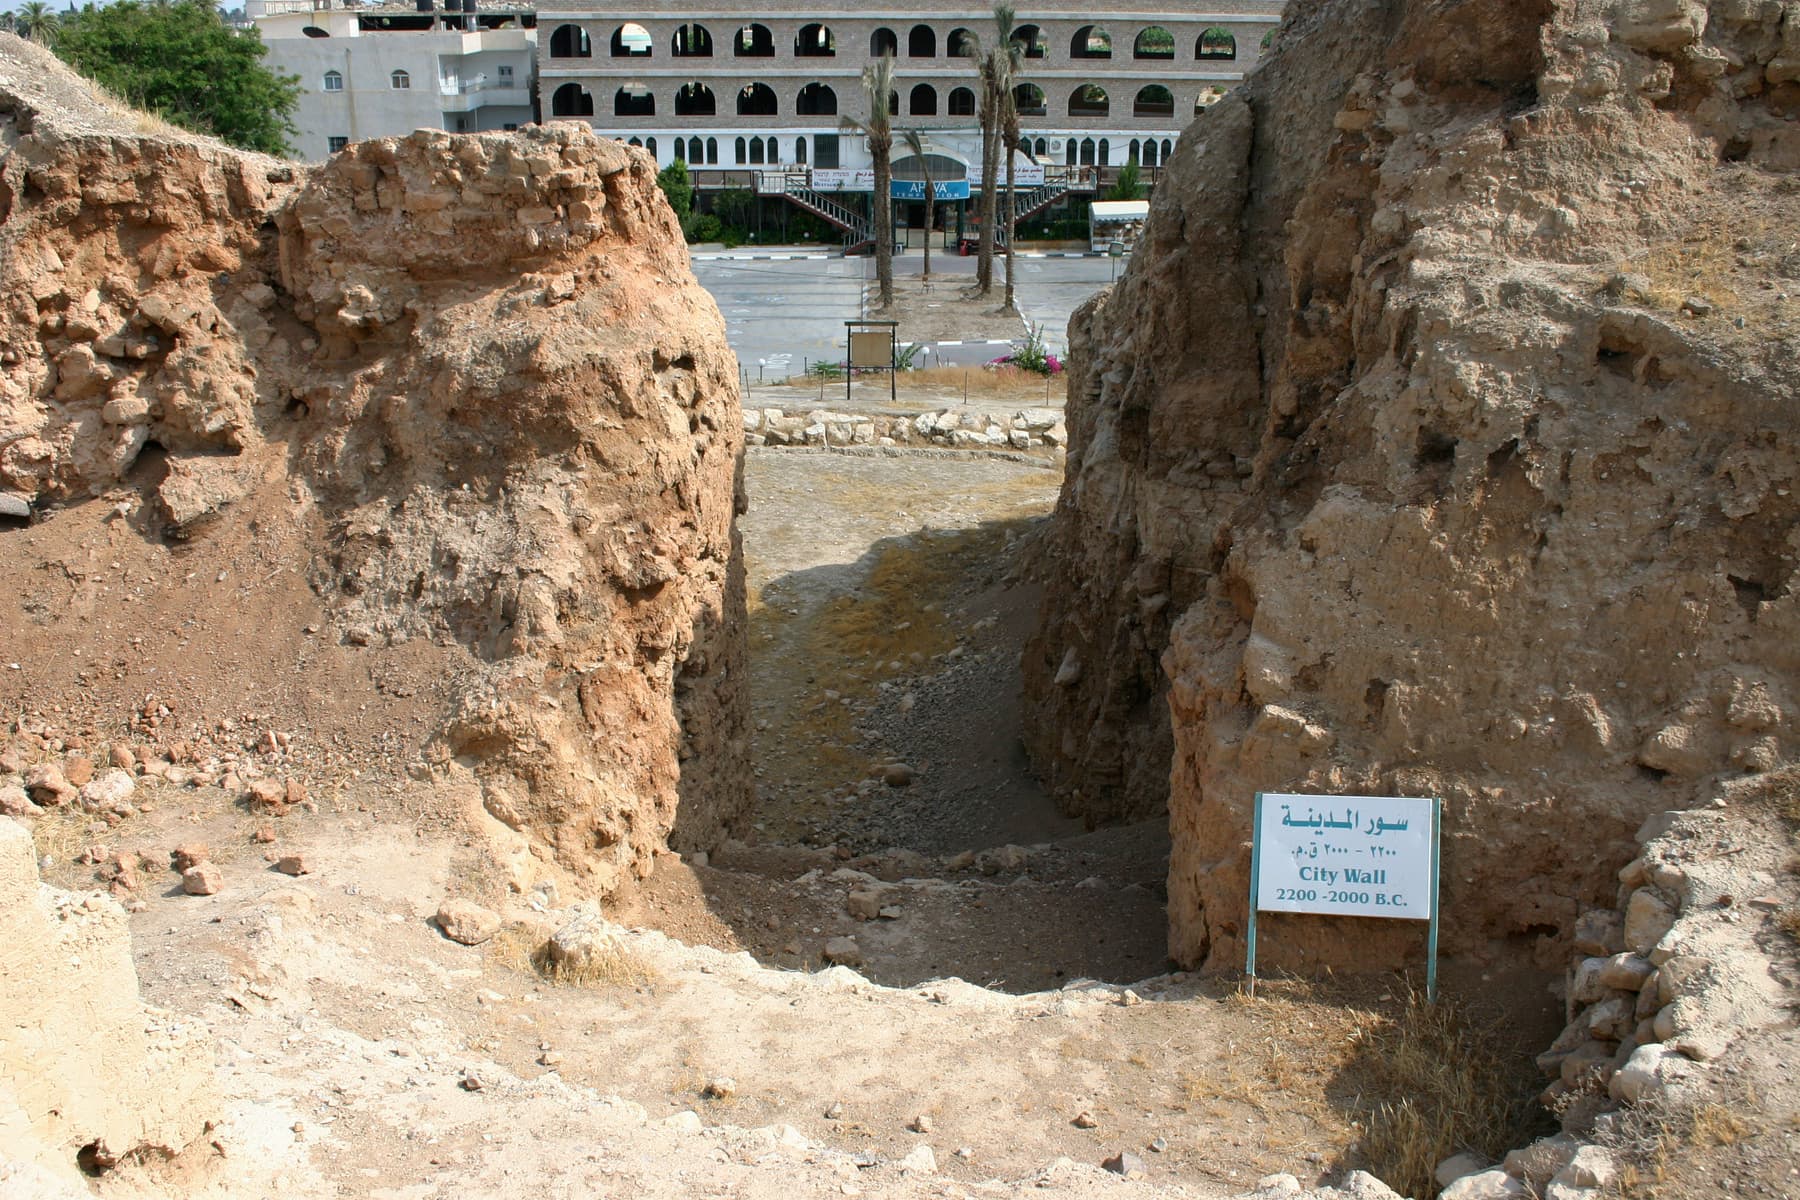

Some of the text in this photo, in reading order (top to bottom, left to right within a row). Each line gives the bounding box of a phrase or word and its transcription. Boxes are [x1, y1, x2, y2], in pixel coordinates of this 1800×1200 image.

[910, 182, 948, 193] AHVA
[1281, 804, 1409, 836] سور المدينة
[1324, 843, 1348, 855] ٢٠٠٠
[1370, 845, 1397, 857] ٢٢٠٠
[1299, 866, 1386, 886] City Wall
[1276, 888, 1317, 902] 2200
[1375, 893, 1408, 907] B.C.
